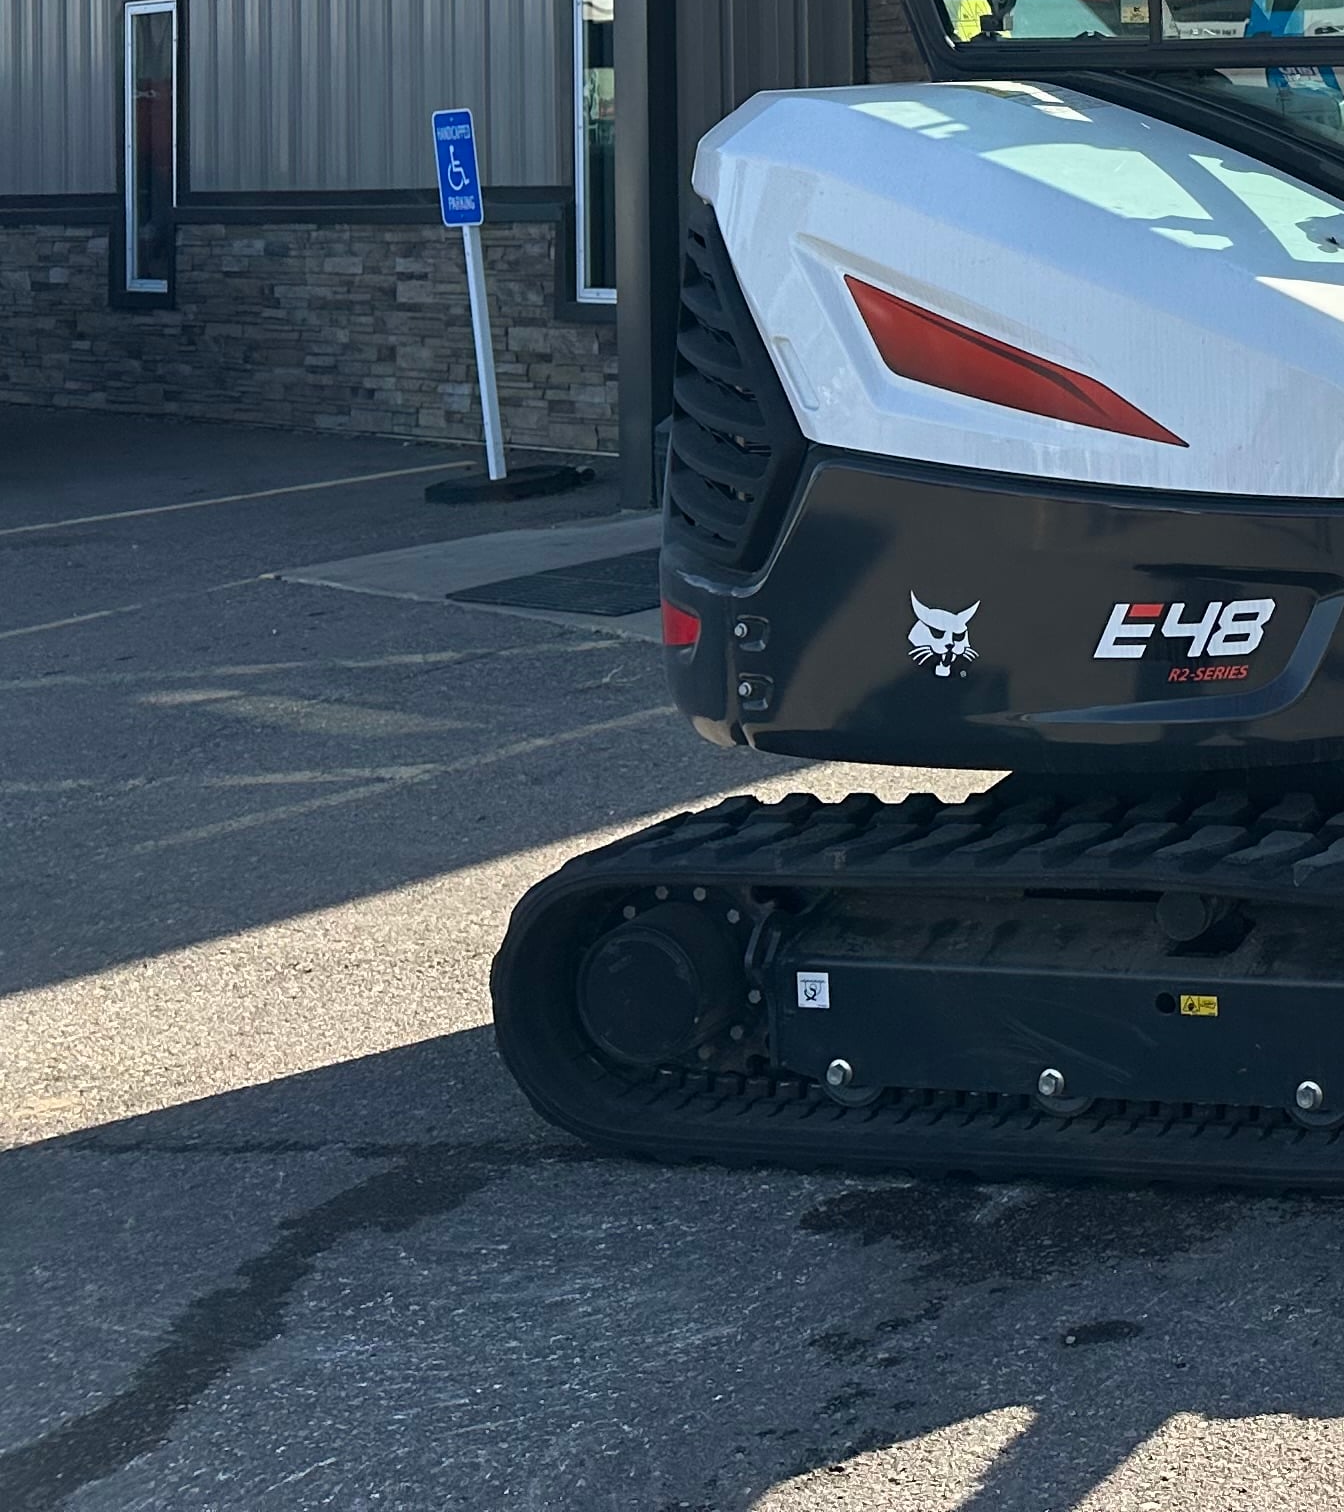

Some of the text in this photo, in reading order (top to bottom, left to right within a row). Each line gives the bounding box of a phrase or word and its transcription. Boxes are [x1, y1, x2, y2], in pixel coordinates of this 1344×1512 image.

[448, 195, 475, 211] PARKING
[1094, 598, 1276, 658] E48
[1168, 665, 1249, 683] R2-SERIES
